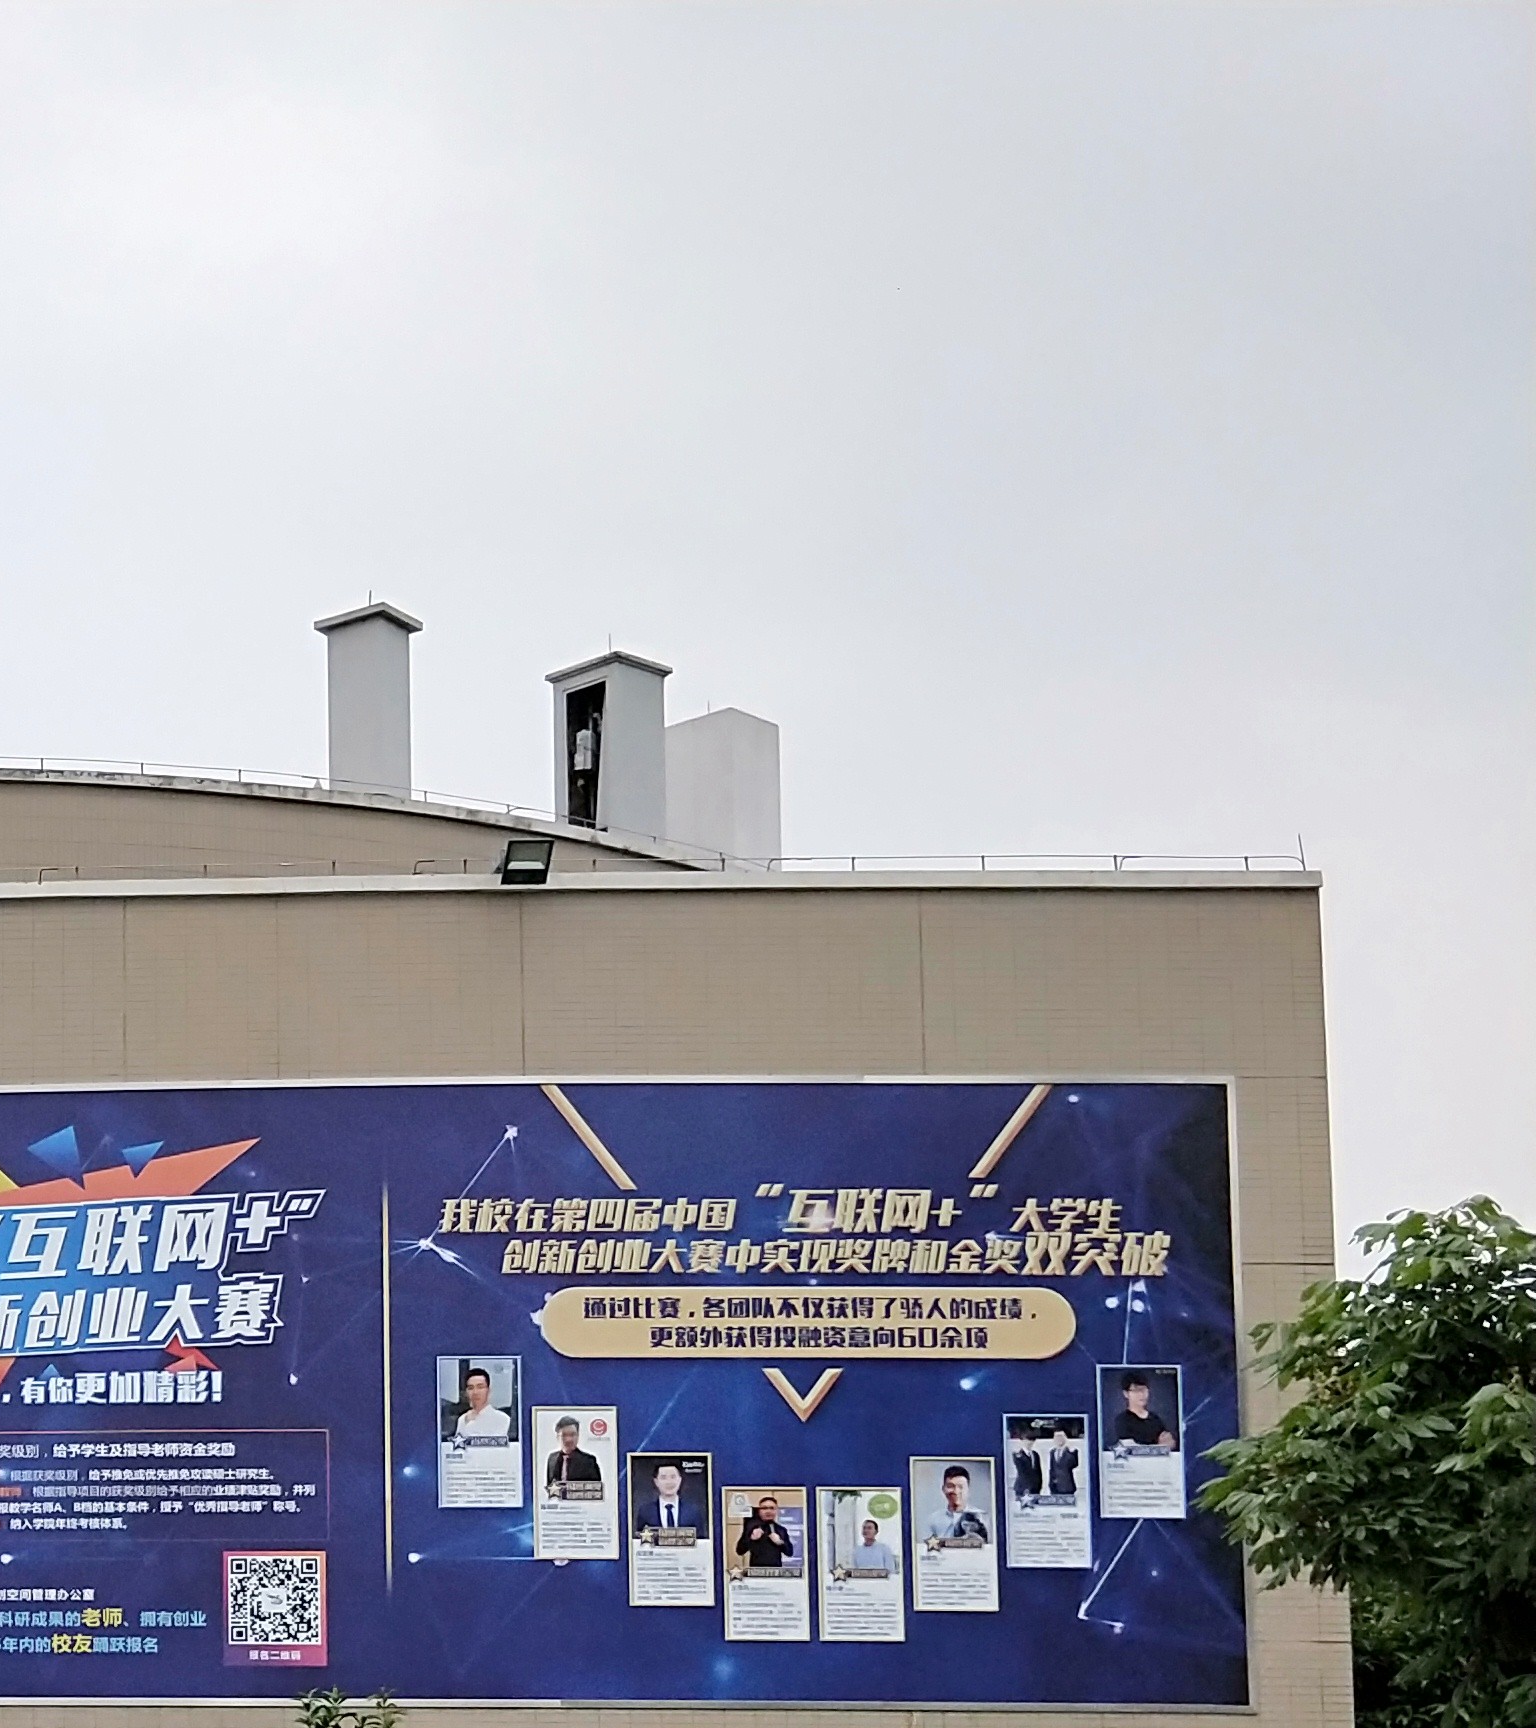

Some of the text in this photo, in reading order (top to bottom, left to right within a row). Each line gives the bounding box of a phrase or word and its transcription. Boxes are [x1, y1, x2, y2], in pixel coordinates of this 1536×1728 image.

[501, 1230, 1171, 1276] 创新创业大赛中实现奖牌和金奖双突破
